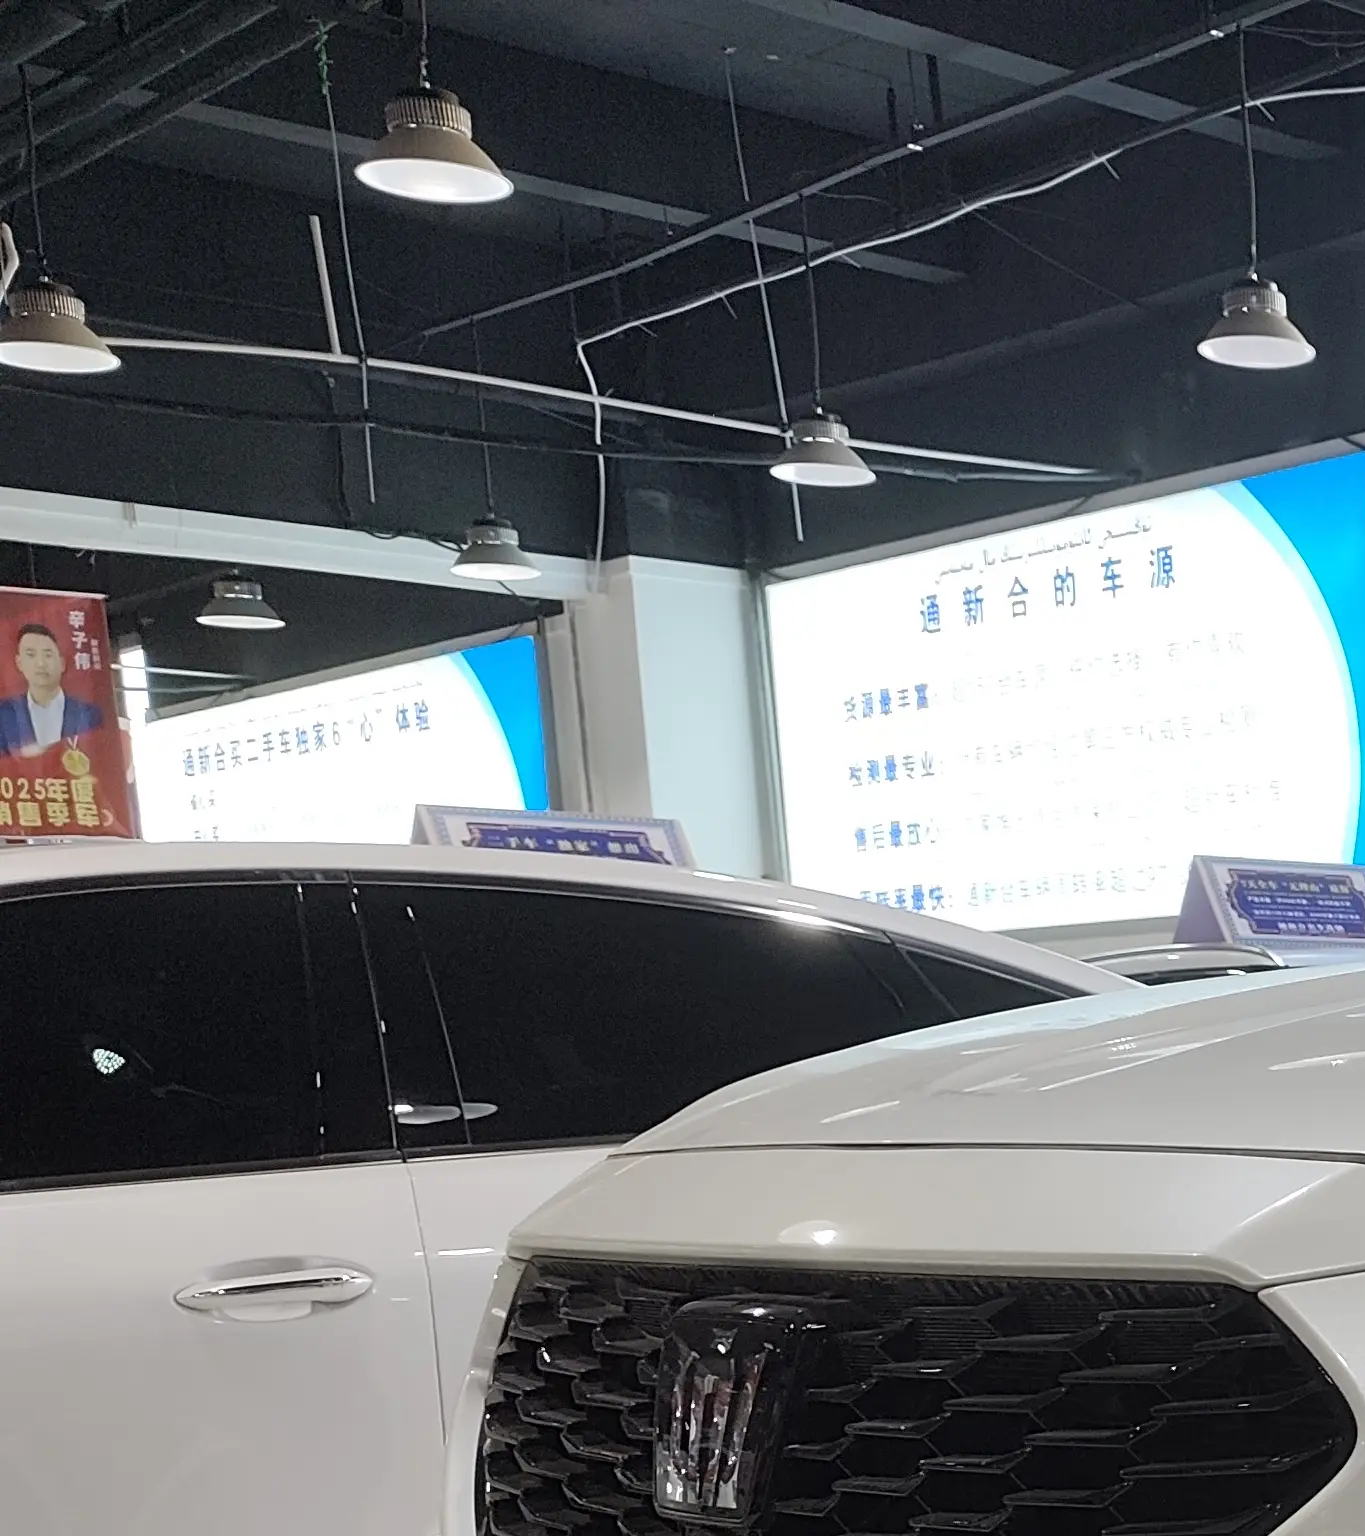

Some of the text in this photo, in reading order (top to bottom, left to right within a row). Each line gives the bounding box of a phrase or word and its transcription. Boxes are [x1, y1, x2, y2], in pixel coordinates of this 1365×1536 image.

[919, 545, 1176, 634] 通新合的车源
